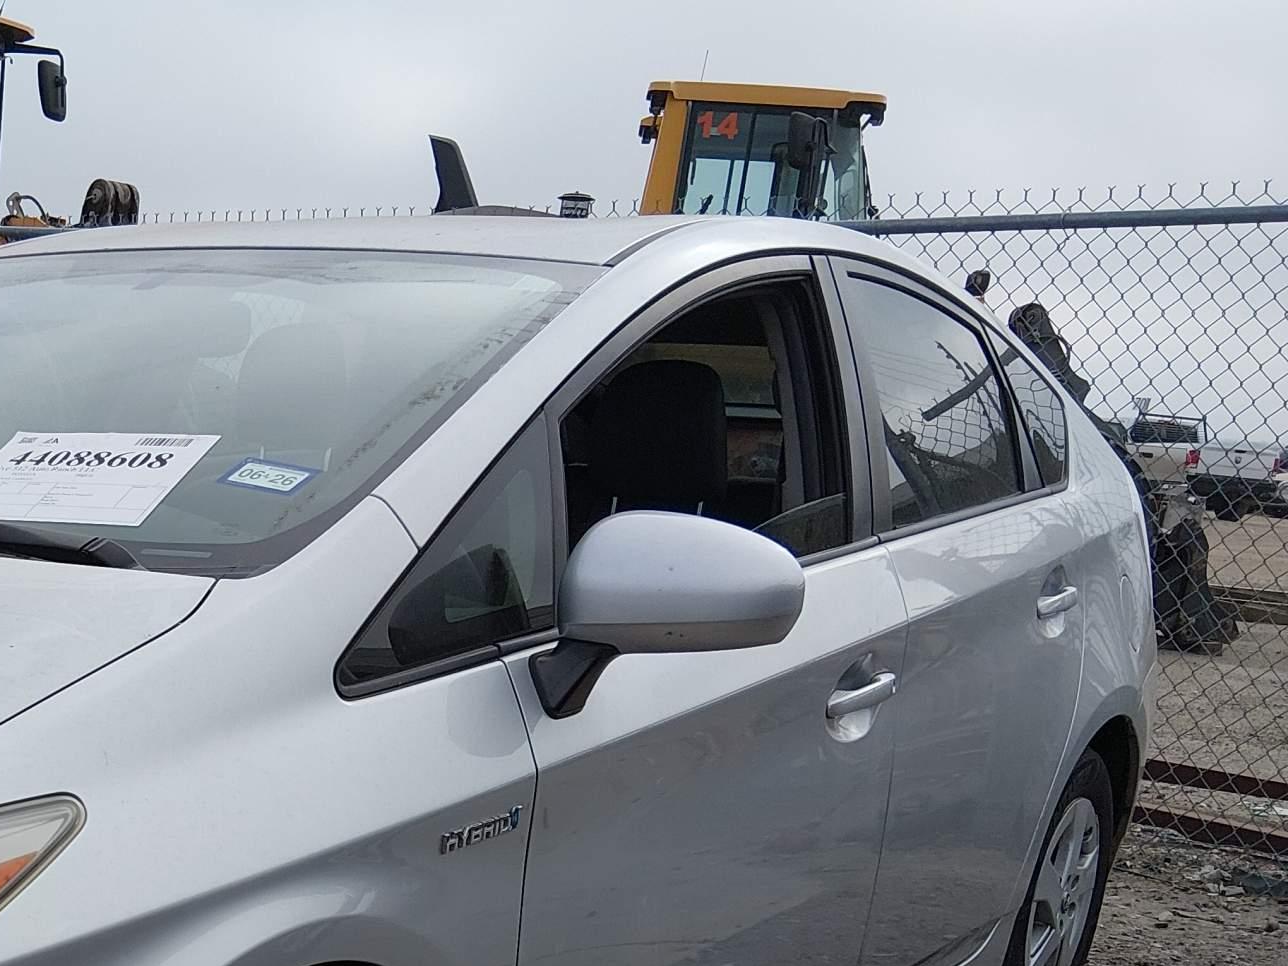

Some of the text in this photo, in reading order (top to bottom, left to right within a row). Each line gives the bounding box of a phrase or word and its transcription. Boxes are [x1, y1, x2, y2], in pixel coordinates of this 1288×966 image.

[697, 110, 739, 140] 14
[9, 449, 175, 469] 44088608
[238, 468, 298, 486] 06 26
[439, 812, 514, 855] HYBRID
